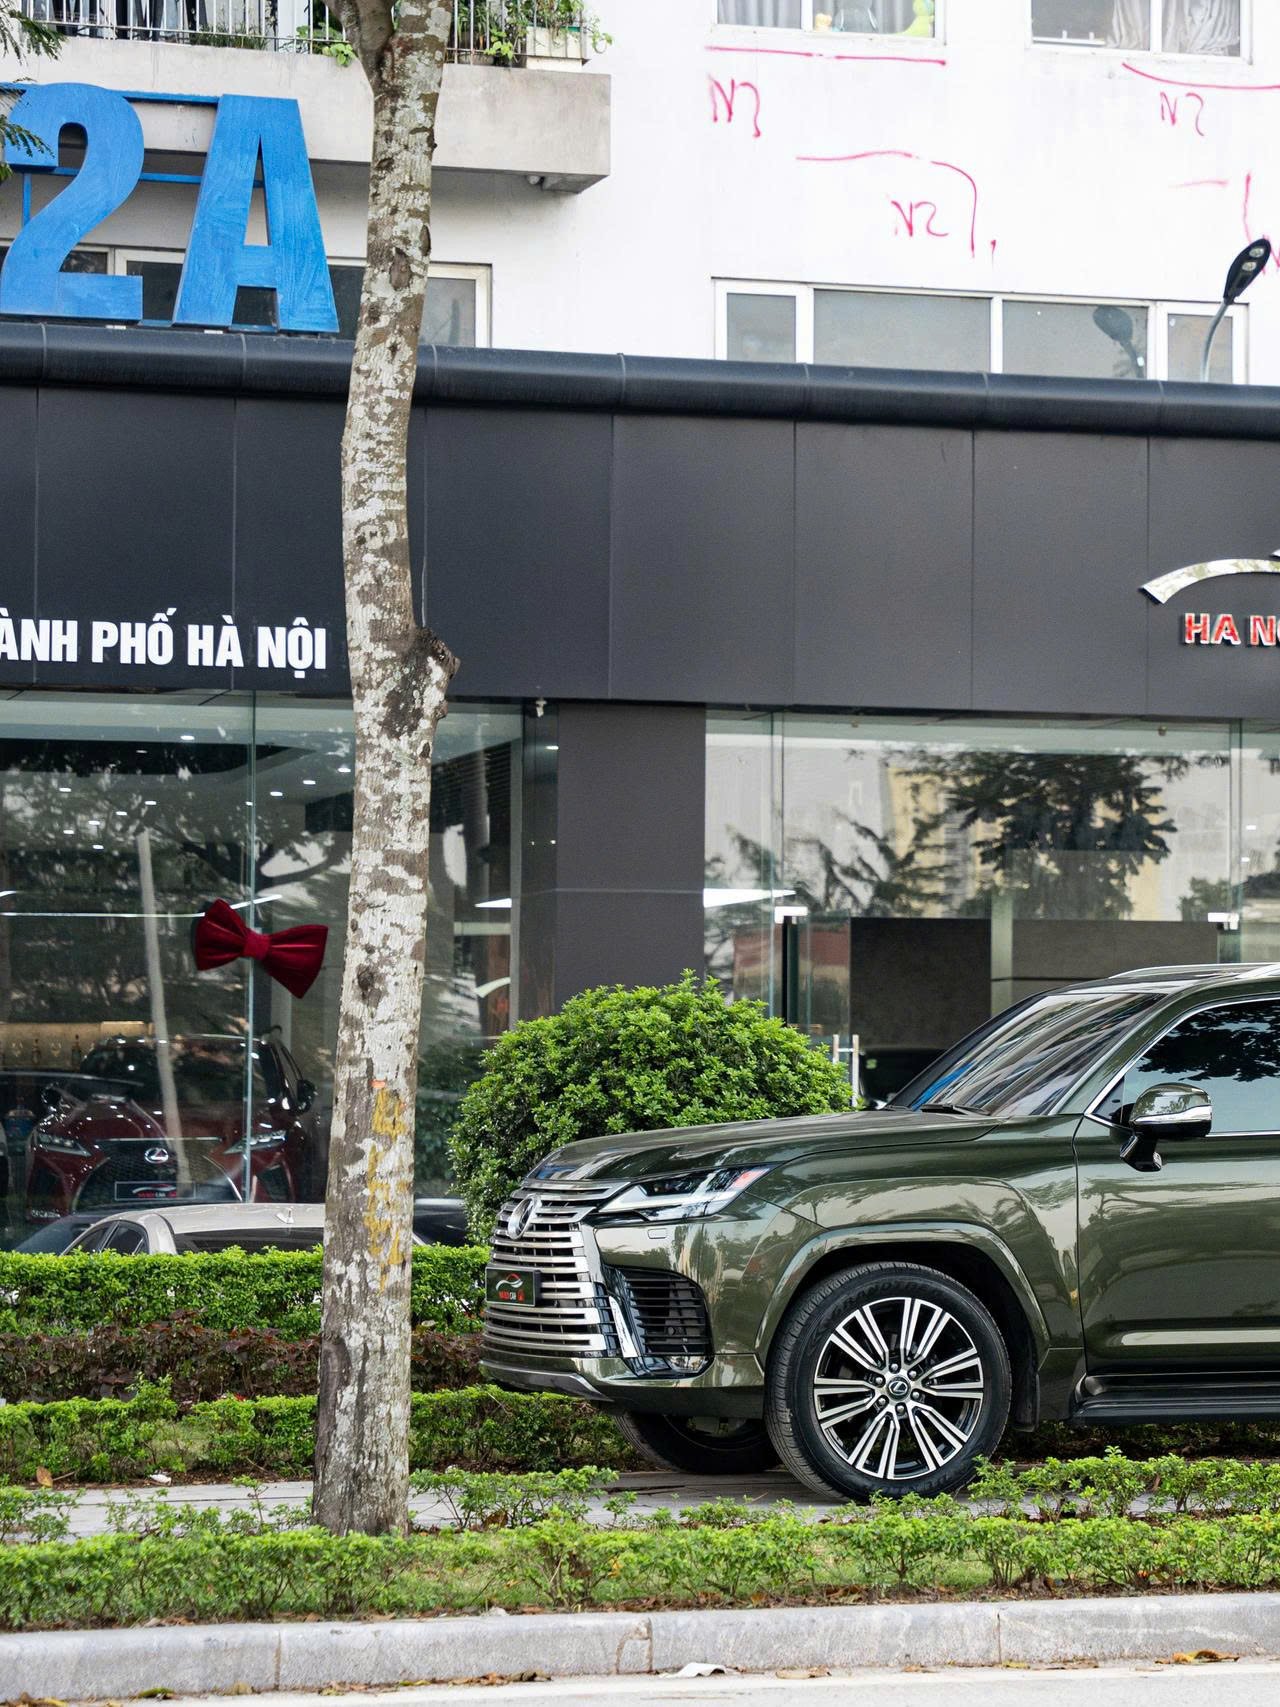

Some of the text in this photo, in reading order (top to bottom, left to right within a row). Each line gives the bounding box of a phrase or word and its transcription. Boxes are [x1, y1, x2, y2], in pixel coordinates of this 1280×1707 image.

[92, 607, 177, 665] PHỐ
[187, 614, 244, 668] HÀ
[257, 616, 327, 679] NỘI
[1183, 611, 1242, 647] HA
